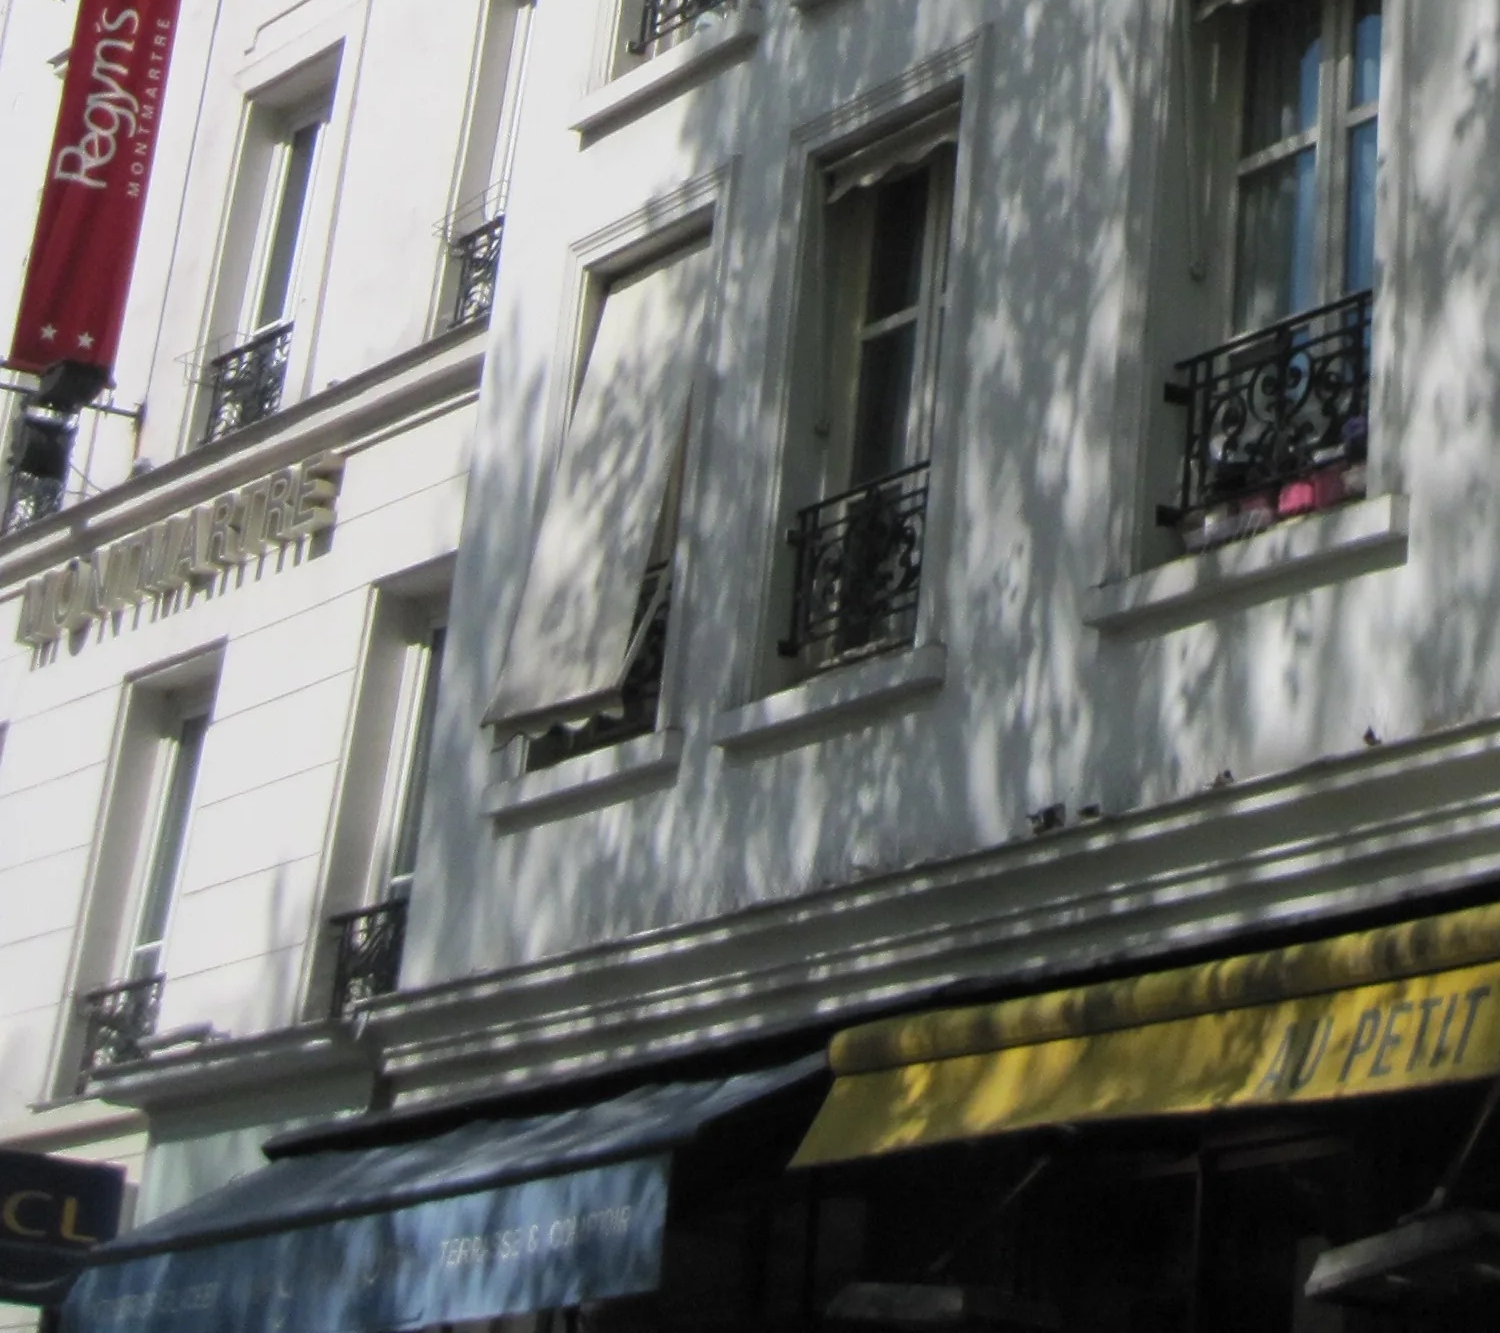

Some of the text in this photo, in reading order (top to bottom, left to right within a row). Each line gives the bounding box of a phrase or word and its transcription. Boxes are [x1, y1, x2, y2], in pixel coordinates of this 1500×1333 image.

[127, 17, 171, 199] MONTMARTRE
[15, 449, 343, 649] MONTMARTRE
[1257, 1019, 1333, 1101] AU
[1340, 985, 1492, 1084] PETIT
